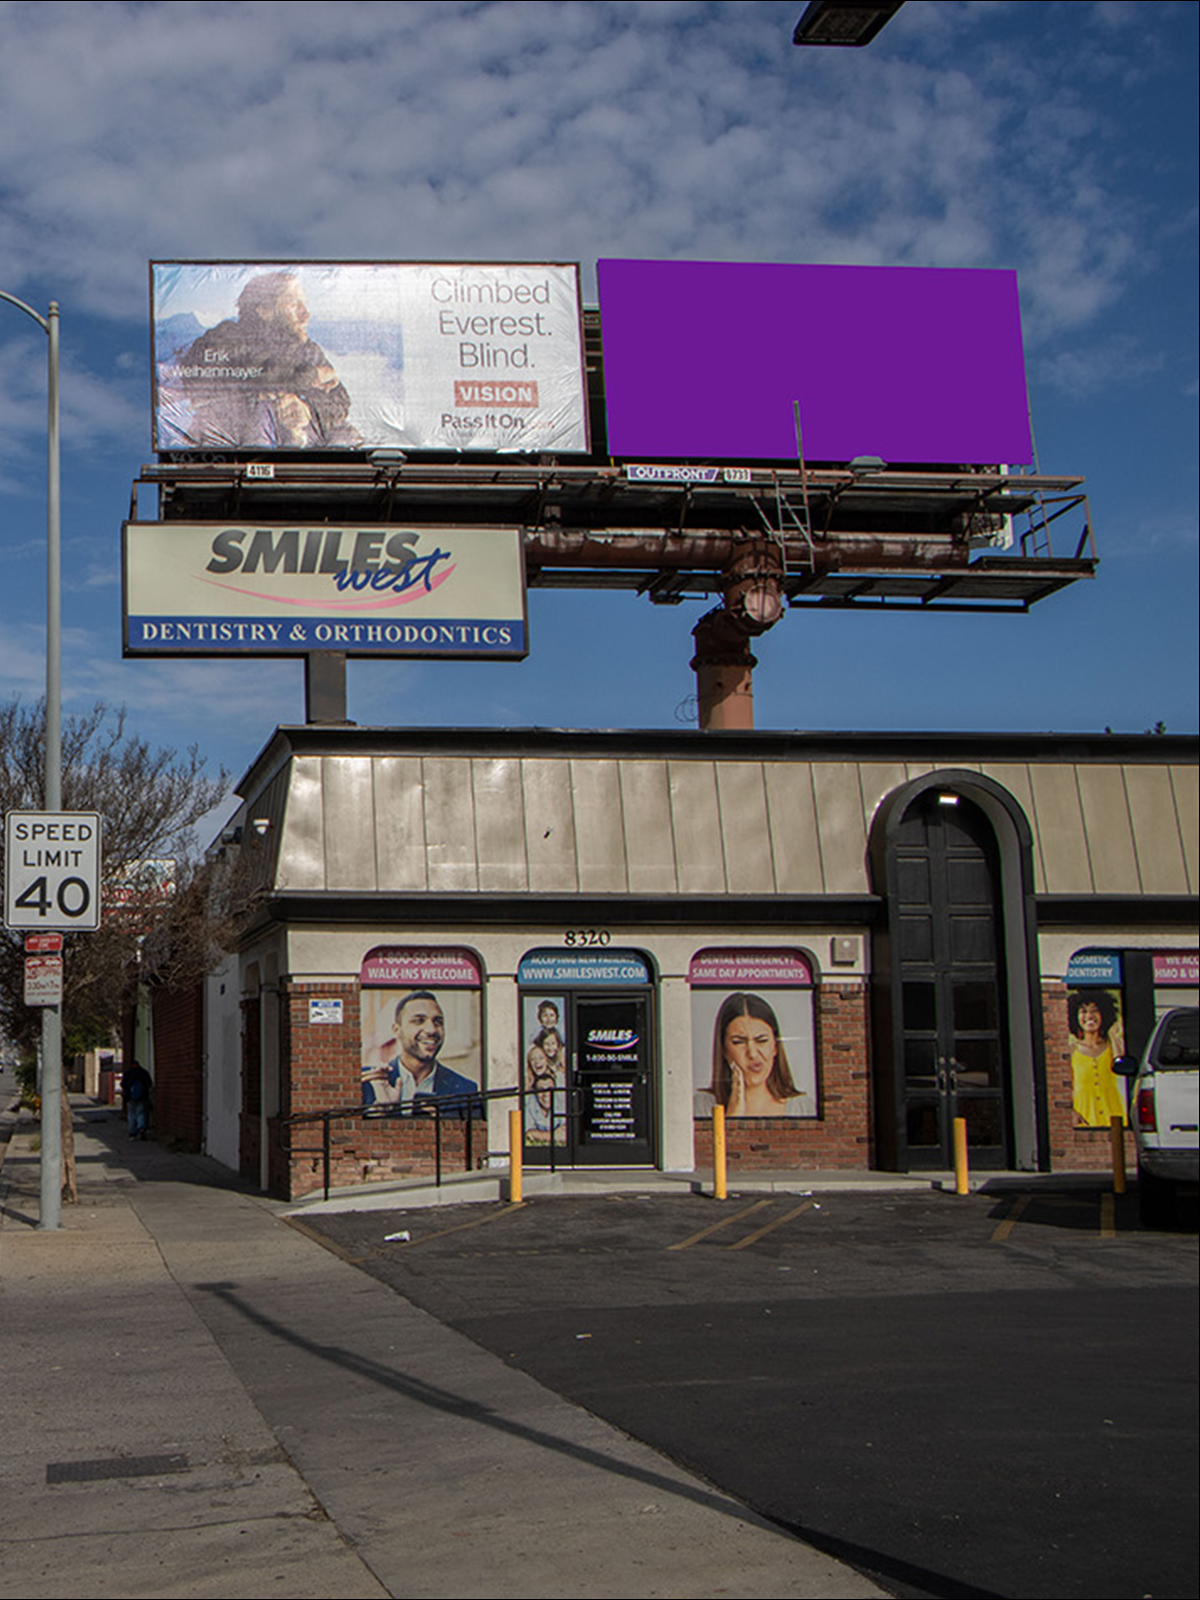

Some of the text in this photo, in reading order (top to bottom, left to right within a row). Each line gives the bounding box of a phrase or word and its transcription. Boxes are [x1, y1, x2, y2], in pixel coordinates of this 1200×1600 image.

[430, 278, 550, 305] Climbed
[438, 310, 553, 336] Everest.
[204, 347, 230, 362] Erik
[459, 342, 536, 369] Blind.
[459, 385, 533, 403] VISION
[636, 465, 709, 480] OUTFRONT
[205, 530, 421, 575] SMILES
[333, 548, 451, 593] west
[142, 622, 512, 645] DENTISTRY & ORTHODONTICS
[15, 823, 92, 842] SPEED
[23, 850, 83, 868] LIMIT
[15, 876, 90, 918] 40
[564, 929, 612, 947] 8320
[701, 954, 734, 965] DENTAL
[1069, 956, 1112, 965] COSMETIC
[1166, 956, 1180, 966] WE
[367, 967, 473, 980] WALK-INS WELCOME
[522, 966, 645, 980] WWW.SMILESWEST.COM
[692, 968, 804, 980] SAME DAY APPOINTMENTS
[1069, 967, 1114, 979] DENTISTRY
[1155, 967, 1178, 979] HMO
[587, 1029, 633, 1042] SMILES
